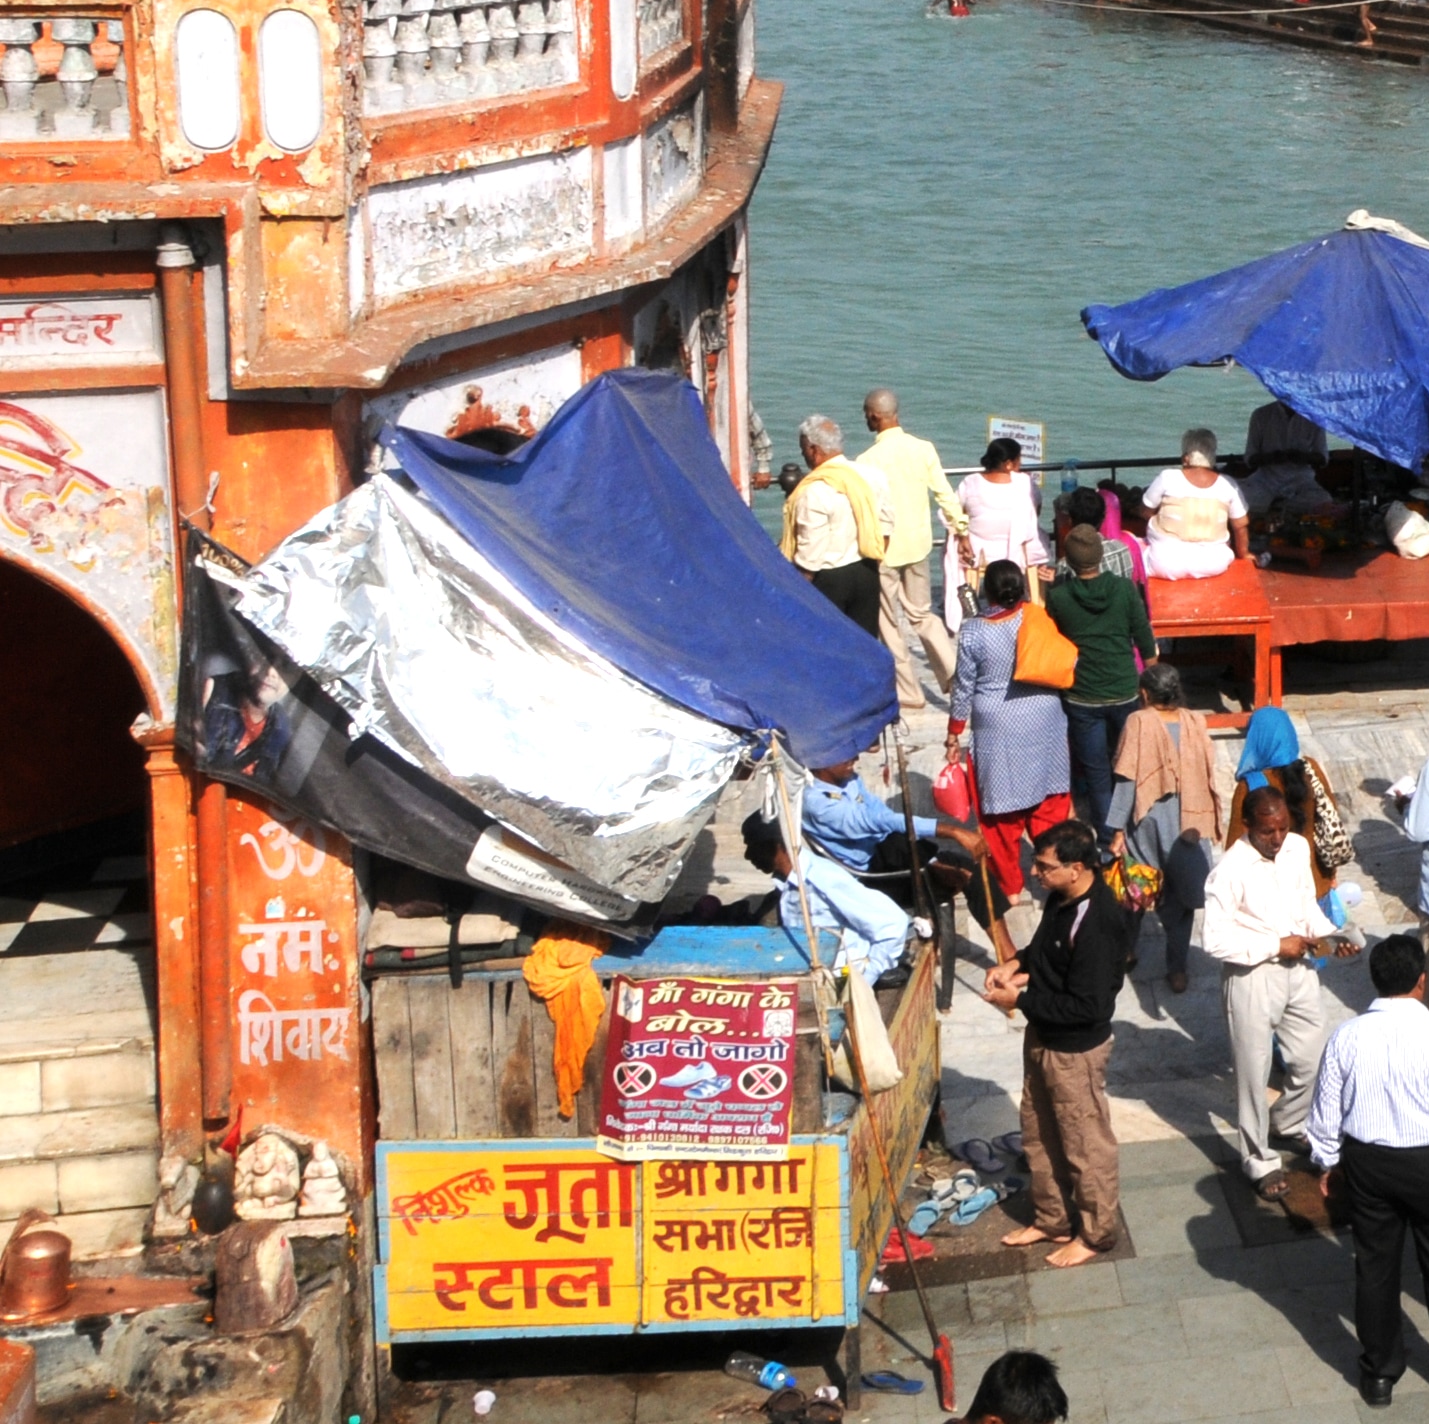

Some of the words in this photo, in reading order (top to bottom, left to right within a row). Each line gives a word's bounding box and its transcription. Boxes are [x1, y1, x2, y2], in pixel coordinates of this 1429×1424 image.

[648, 981, 686, 1005] माँ
[690, 985, 754, 1008] गंगा
[758, 986, 794, 1008] के
[621, 1039, 669, 1061] अब
[672, 1035, 709, 1059] तो
[711, 1038, 790, 1062] जागो
[502, 1162, 636, 1244] जूता
[432, 1257, 613, 1312] स्टाल
[664, 1267, 806, 1320] हरिद्वार
